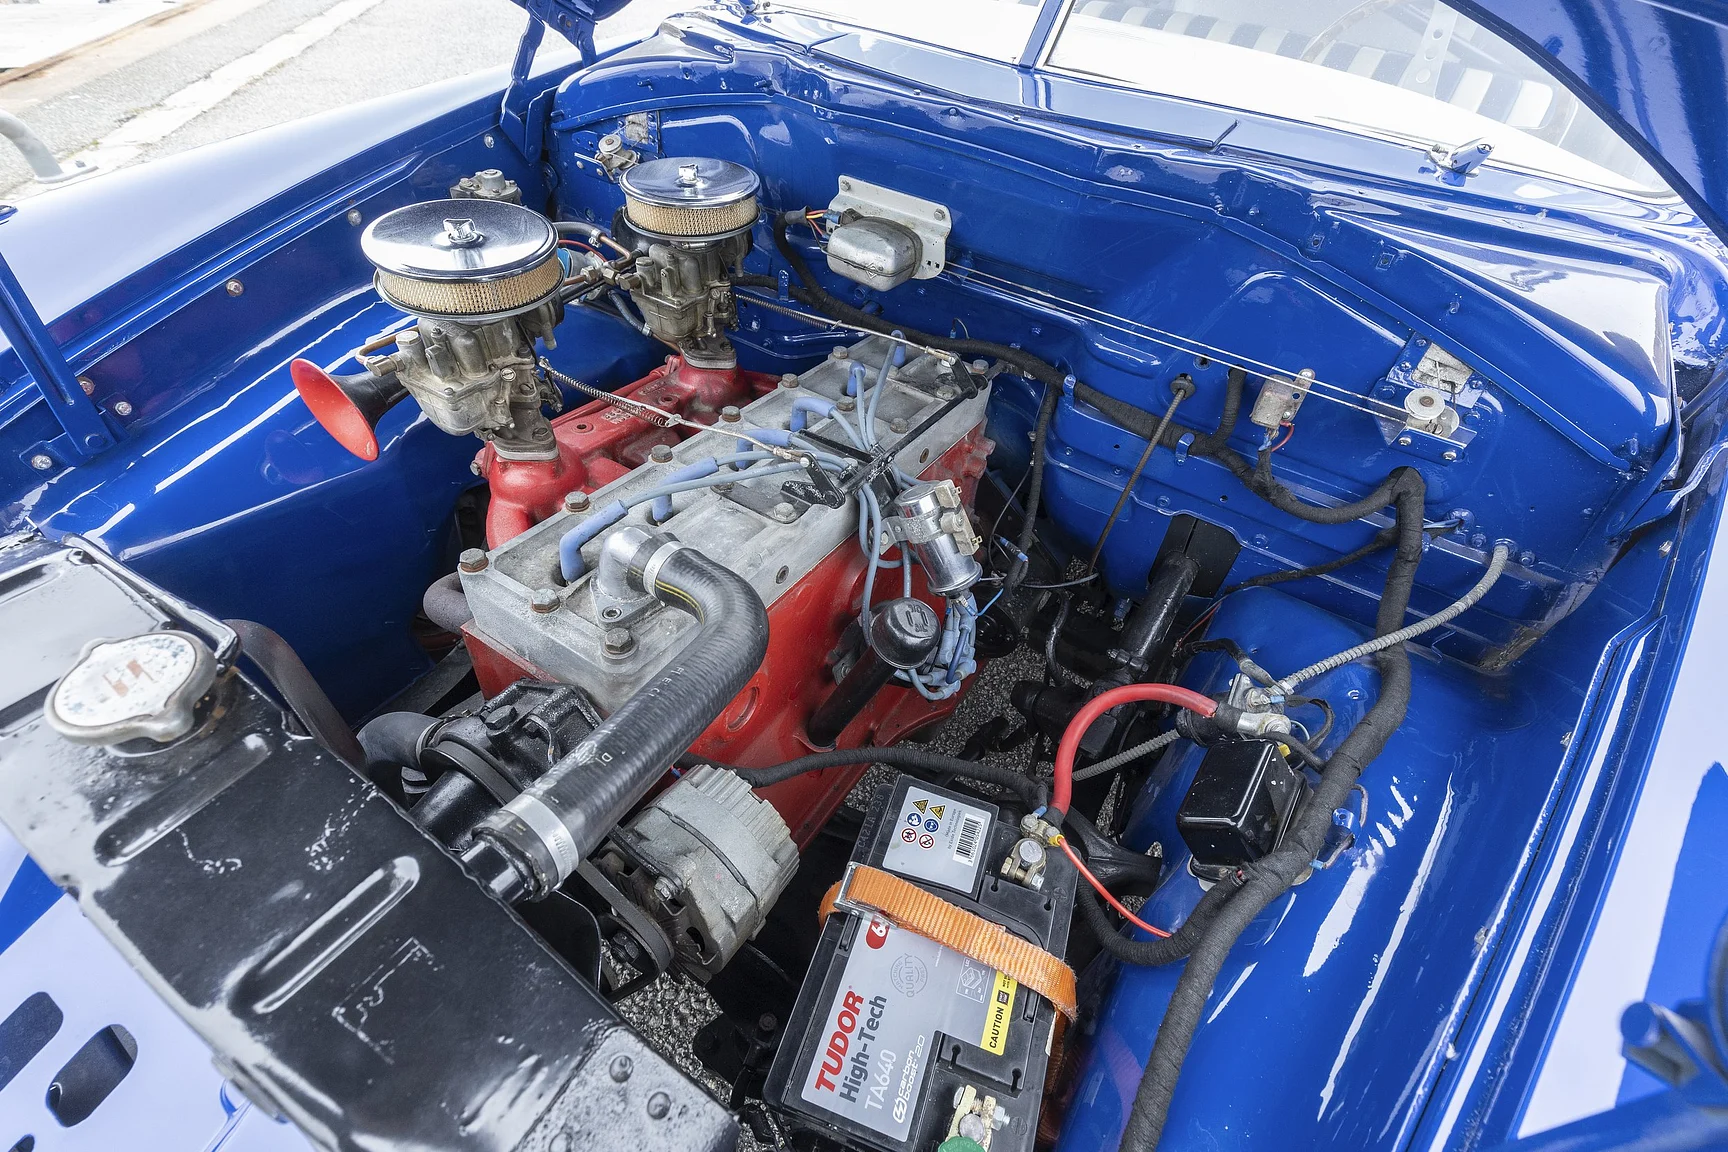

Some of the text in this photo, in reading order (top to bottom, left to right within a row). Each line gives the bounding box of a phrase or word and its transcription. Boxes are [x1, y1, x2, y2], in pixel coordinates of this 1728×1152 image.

[904, 953, 915, 998] QUALITY
[815, 990, 864, 1093] TUDOR
[839, 995, 887, 1103] High-Tech
[990, 1006, 1004, 1048] CAUTION
[865, 1049, 896, 1110] TA640
[898, 1050, 914, 1097] carbon
